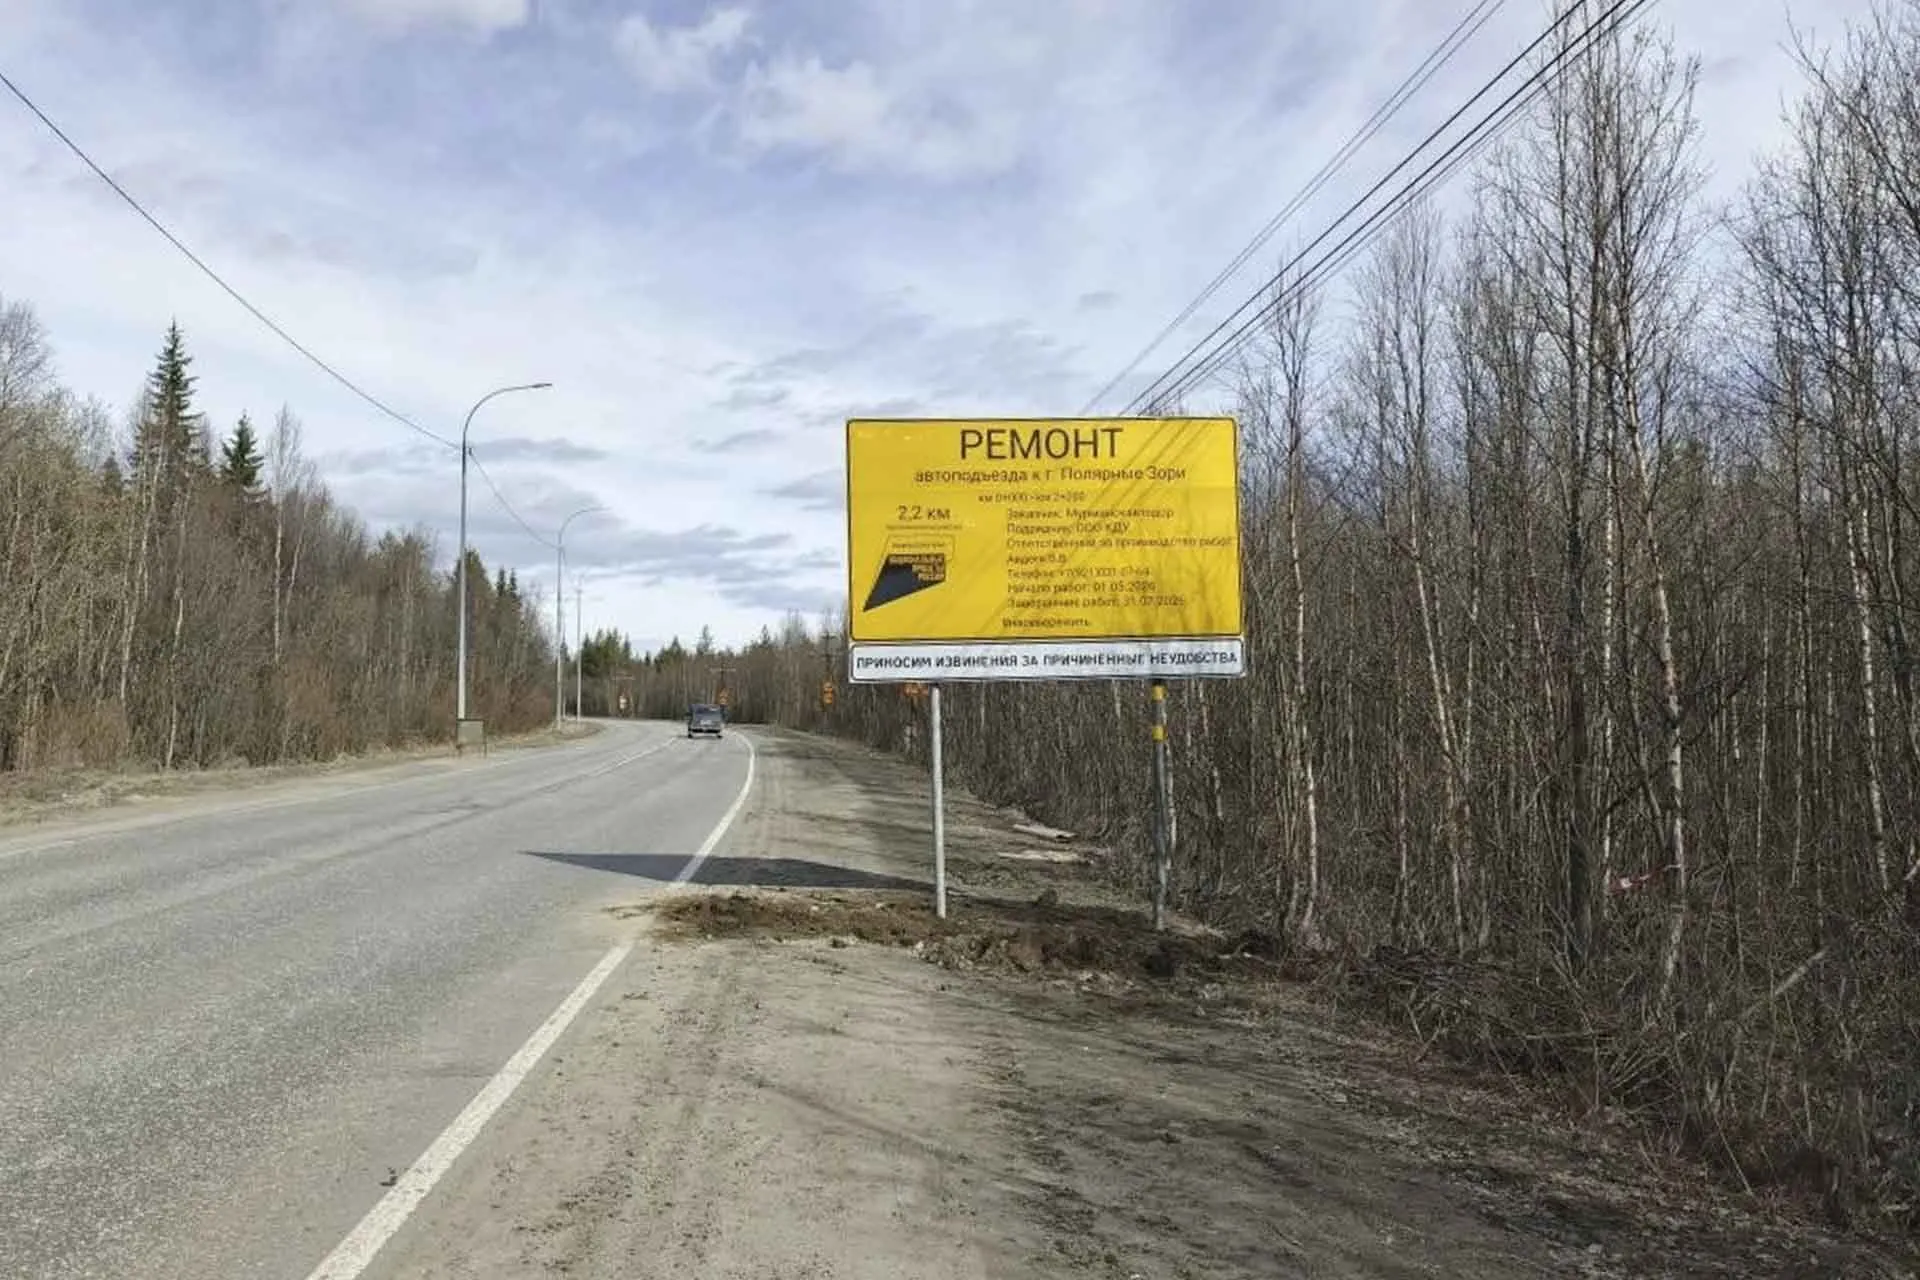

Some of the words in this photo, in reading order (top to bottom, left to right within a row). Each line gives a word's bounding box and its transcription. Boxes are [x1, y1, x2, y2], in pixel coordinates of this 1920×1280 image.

[960, 428, 1123, 460] РЕМОНТ
[914, 468, 1027, 484] автоподъезда
[1032, 470, 1041, 481] к
[1061, 466, 1143, 483] Полярные
[1149, 465, 1186, 482] Зори
[898, 505, 922, 521] 2,2
[928, 508, 951, 520] км
[856, 655, 932, 669] ПРИНОСИМ
[936, 655, 1018, 668] ИЗВИНЕНИЯ
[1022, 655, 1038, 667] ЗА
[1043, 653, 1145, 667] ПРИЧИНЕННЫЕ
[1150, 651, 1237, 665] НЕУДОБСТВА
